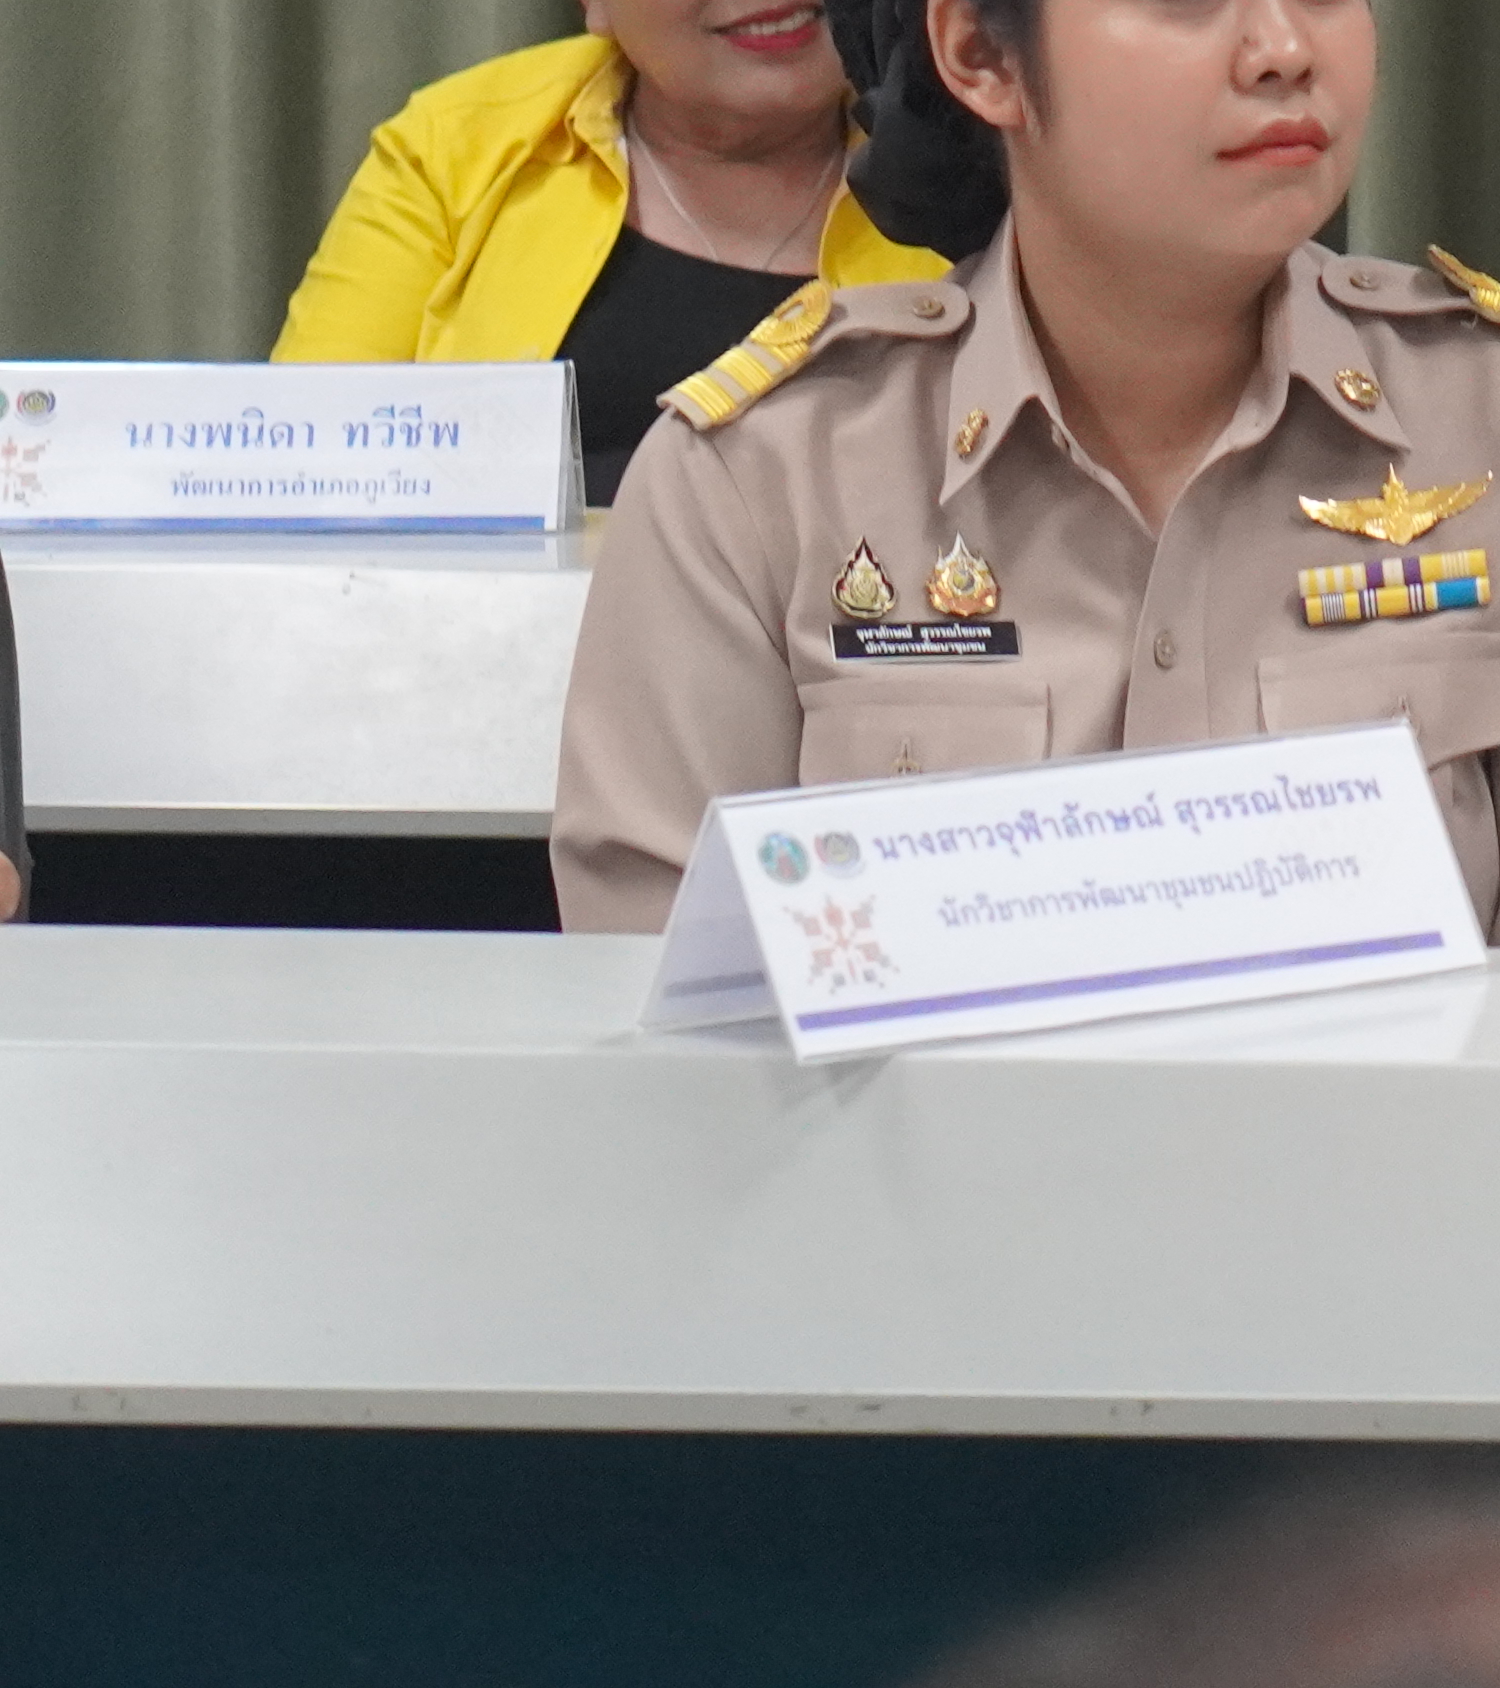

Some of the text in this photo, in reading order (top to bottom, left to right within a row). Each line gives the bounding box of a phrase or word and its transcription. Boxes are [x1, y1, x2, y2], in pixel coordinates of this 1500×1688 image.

[125, 403, 460, 449] นางพนิดา ทวีชีพ
